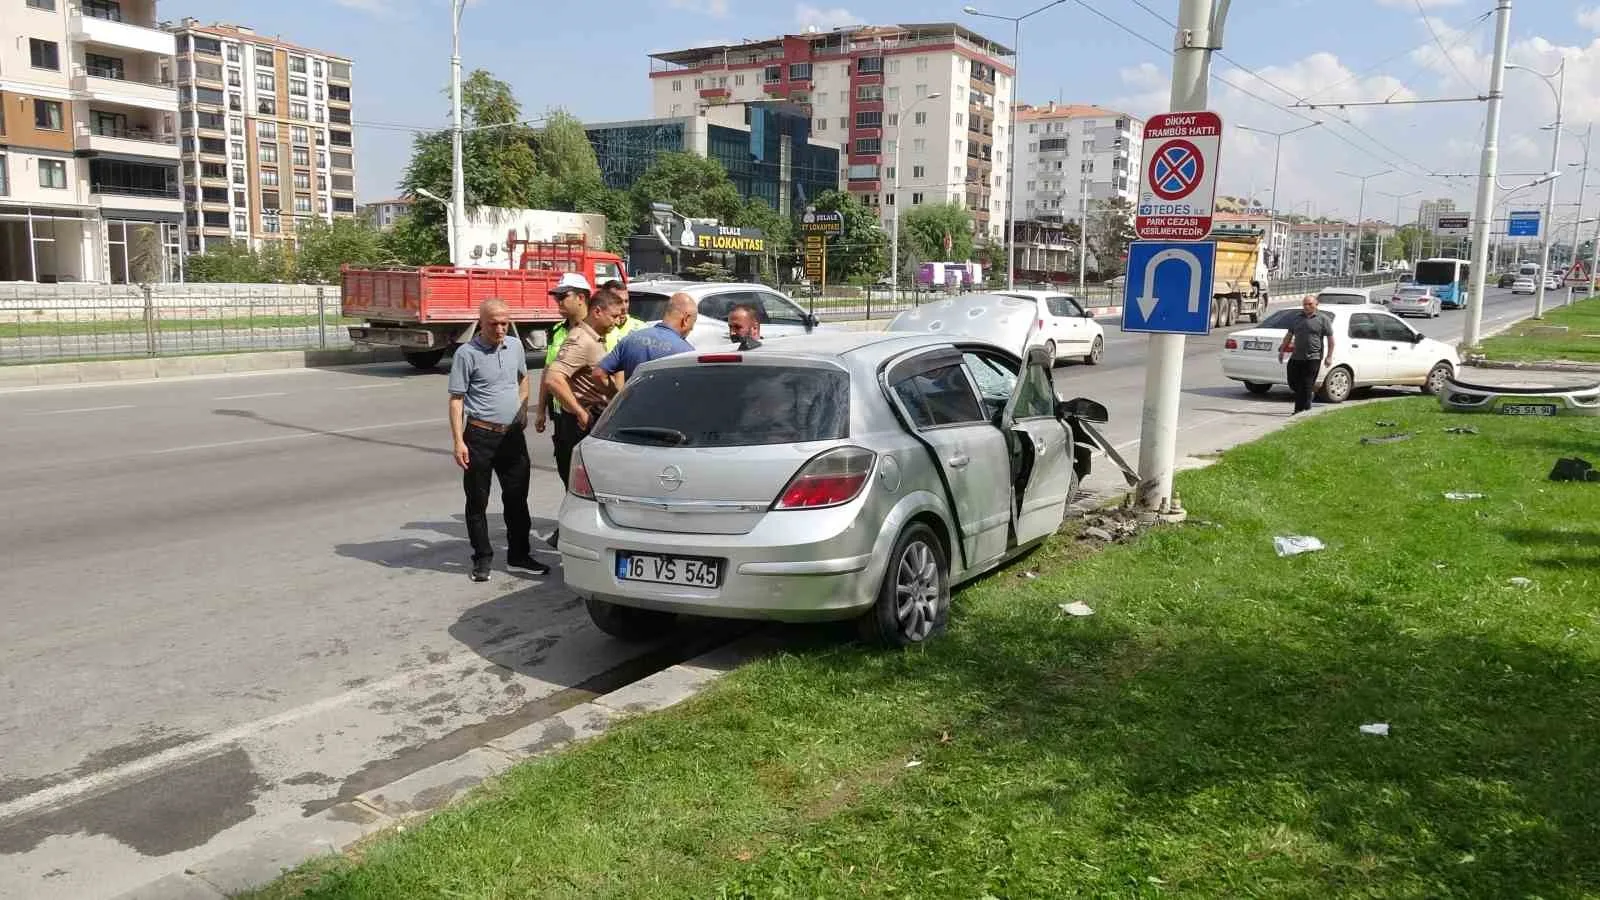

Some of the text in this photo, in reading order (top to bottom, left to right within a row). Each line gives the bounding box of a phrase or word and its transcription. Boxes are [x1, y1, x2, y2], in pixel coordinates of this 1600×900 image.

[1165, 116, 1197, 126] DİKKAT
[1148, 126, 1216, 137] TRAMBÜS HATTI
[1152, 205, 1191, 215] TEDES
[1146, 218, 1198, 226] PARK CEZASI
[1141, 226, 1204, 236] KESİLMEKTEDİR
[698, 235, 763, 251] ET LOKANTASI
[628, 557, 716, 585] 16 VS 545
